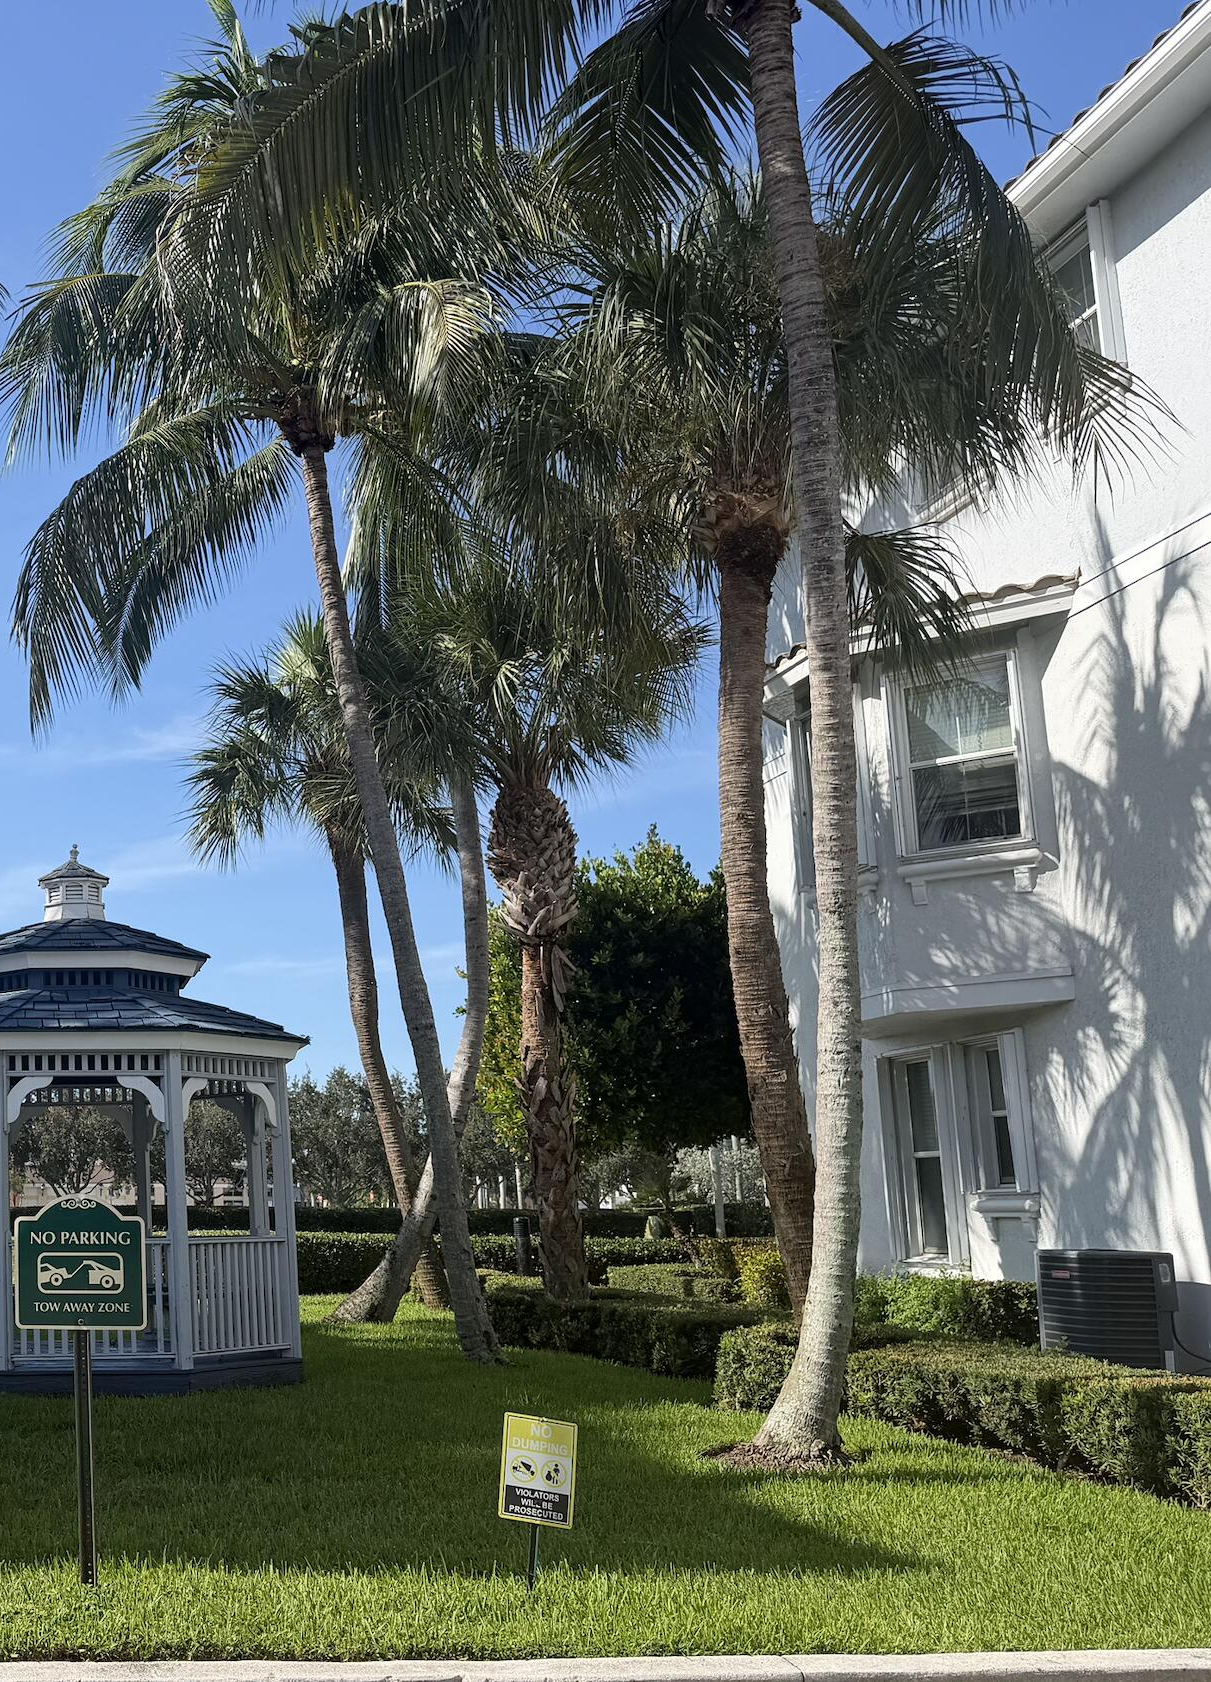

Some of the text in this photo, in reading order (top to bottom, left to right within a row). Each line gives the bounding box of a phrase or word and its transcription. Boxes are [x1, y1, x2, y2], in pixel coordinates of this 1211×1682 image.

[30, 1231, 131, 1245] NO PARKING
[33, 1302, 130, 1313] TOW AWAY ZONE
[530, 1423, 553, 1439] NO
[512, 1436, 568, 1456] DUMPING
[515, 1488, 560, 1502] VIOLATORS
[509, 1504, 564, 1520] PROSECUTED
[542, 1500, 553, 1510] BE
